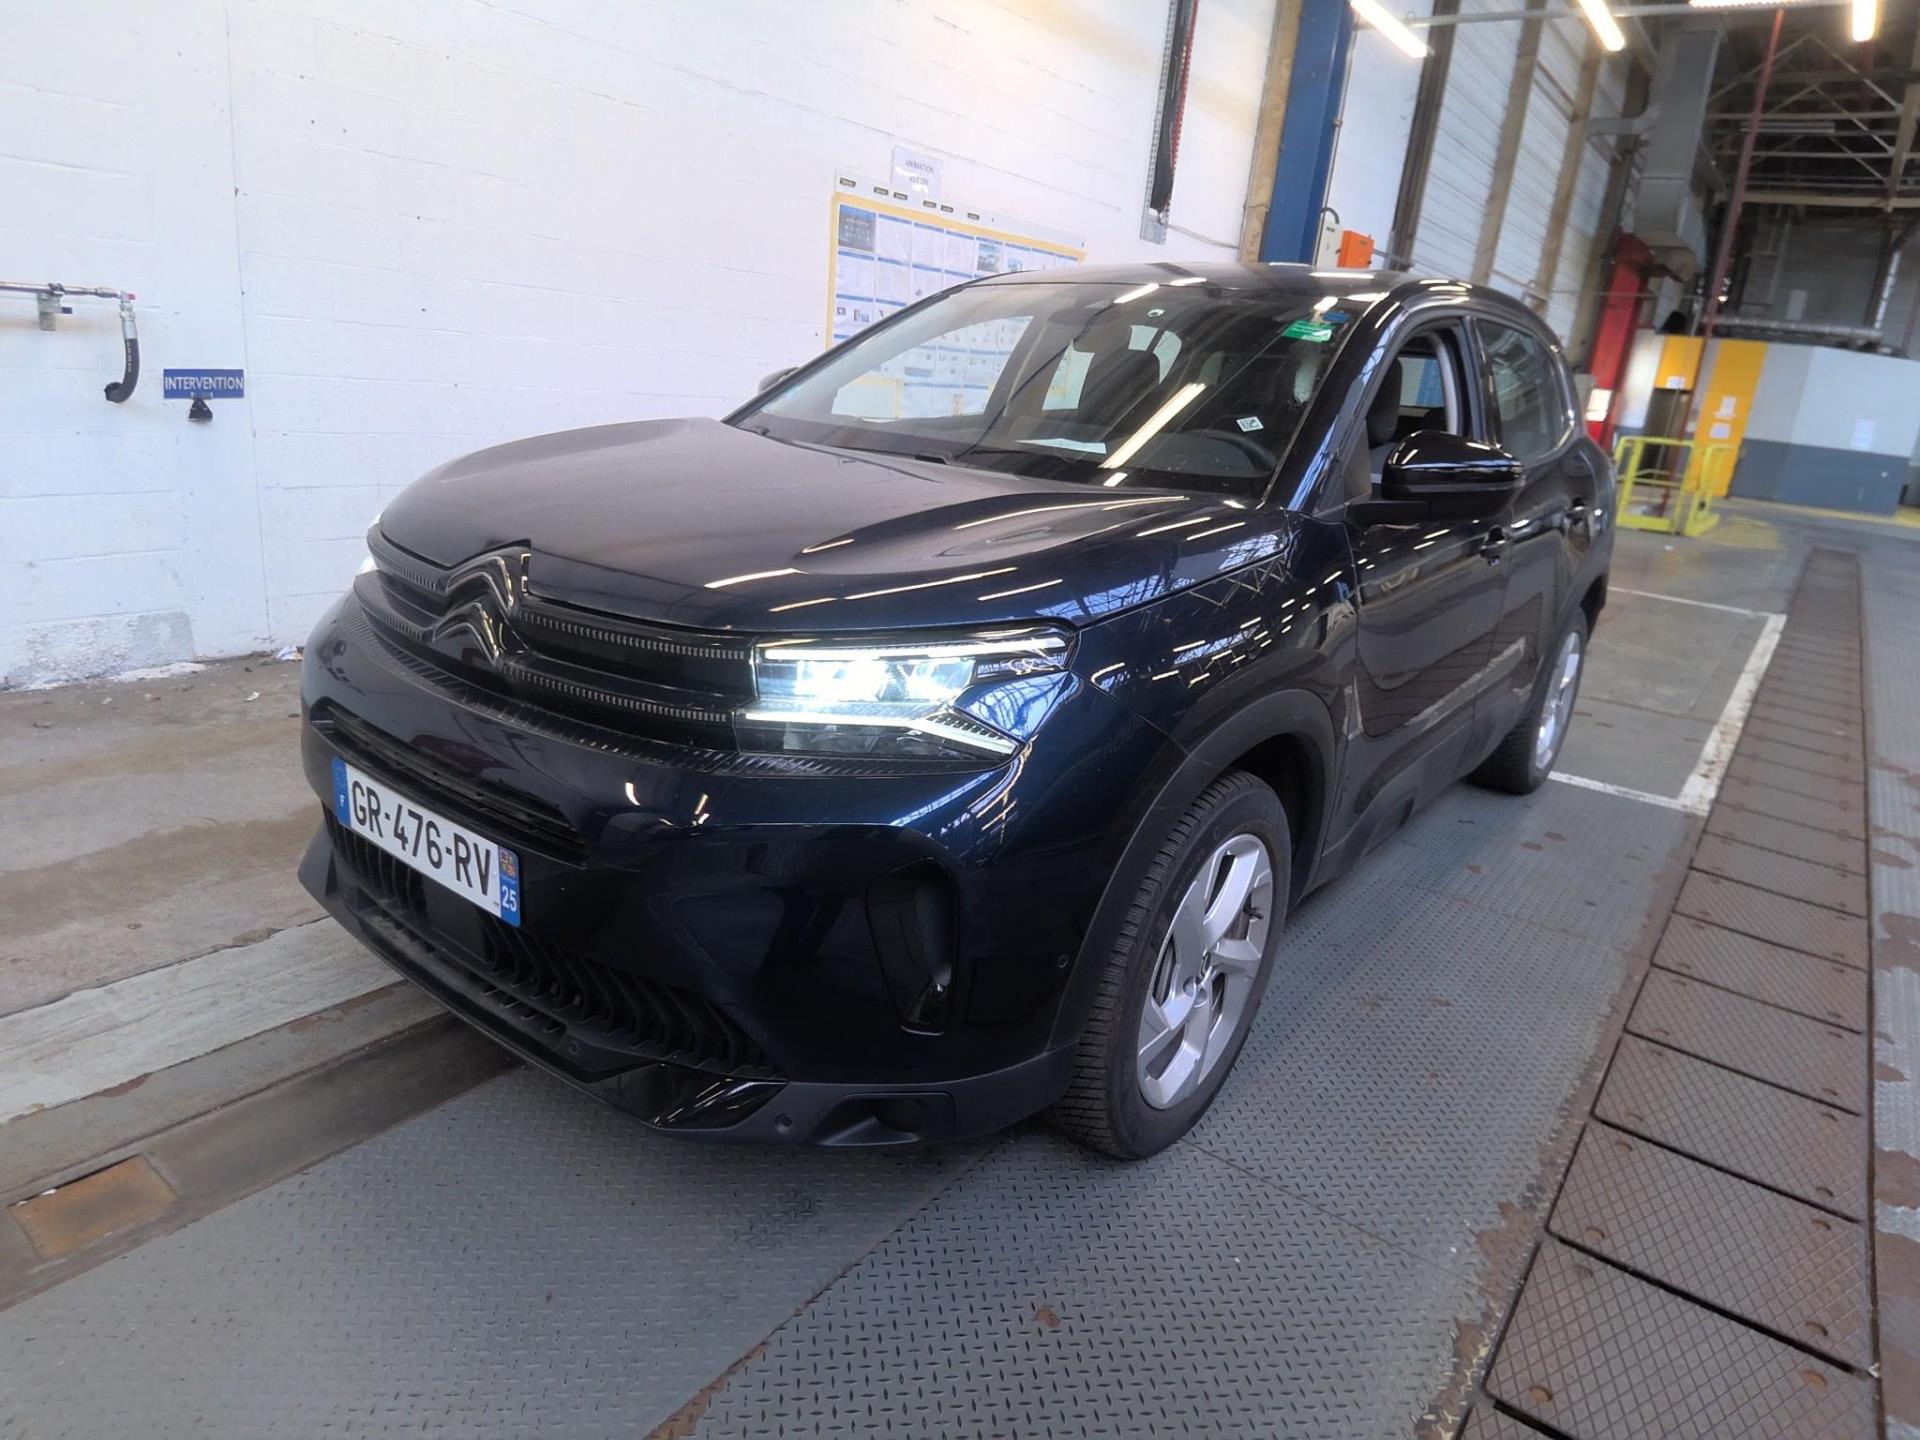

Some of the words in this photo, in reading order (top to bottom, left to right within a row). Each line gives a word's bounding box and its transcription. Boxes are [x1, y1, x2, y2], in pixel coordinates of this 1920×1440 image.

[165, 376, 243, 391] INTERVENTION
[352, 780, 492, 896] GR-476-RV
[502, 885, 517, 912] 25
